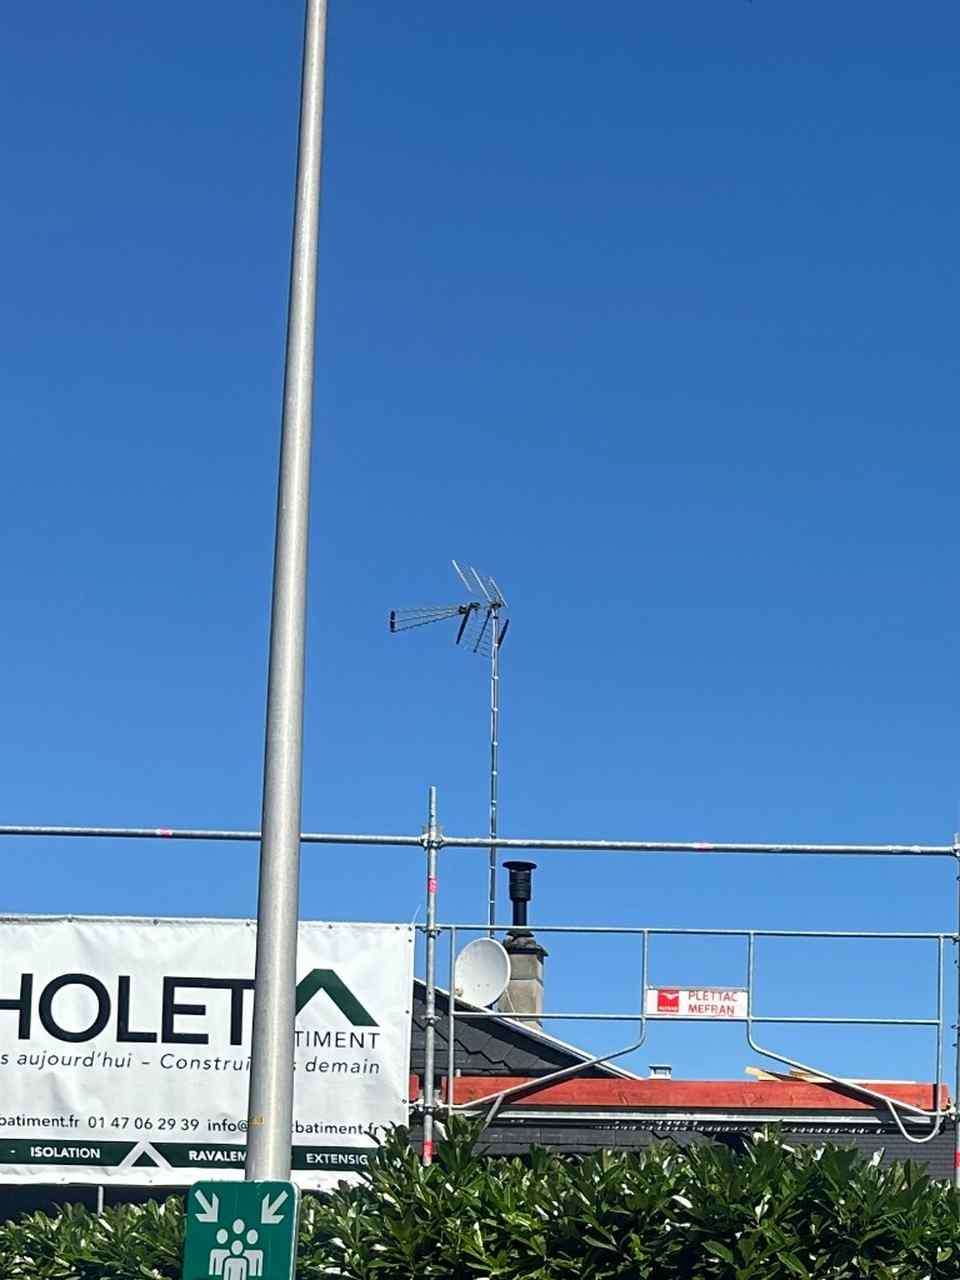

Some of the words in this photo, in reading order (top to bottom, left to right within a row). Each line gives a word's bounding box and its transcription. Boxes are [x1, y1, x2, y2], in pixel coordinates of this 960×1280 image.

[688, 990, 737, 1002] PLETTAC
[688, 1003, 735, 1016] MEFRAN
[294, 1030, 381, 1049] TIMENT
[17, 1050, 133, 1070] aujourd'hui
[160, 1053, 296, 1072] Construi
[305, 1056, 380, 1074] demain
[88, 1116, 105, 1128] 01
[110, 1117, 129, 1128] 47
[134, 1117, 153, 1130] 06
[158, 1118, 176, 1130] 29
[181, 1118, 200, 1131] 39
[207, 1118, 379, 1136] info@batiment.fr
[30, 1146, 101, 1159] ISOLATION
[189, 1150, 247, 1162] RAVALEM
